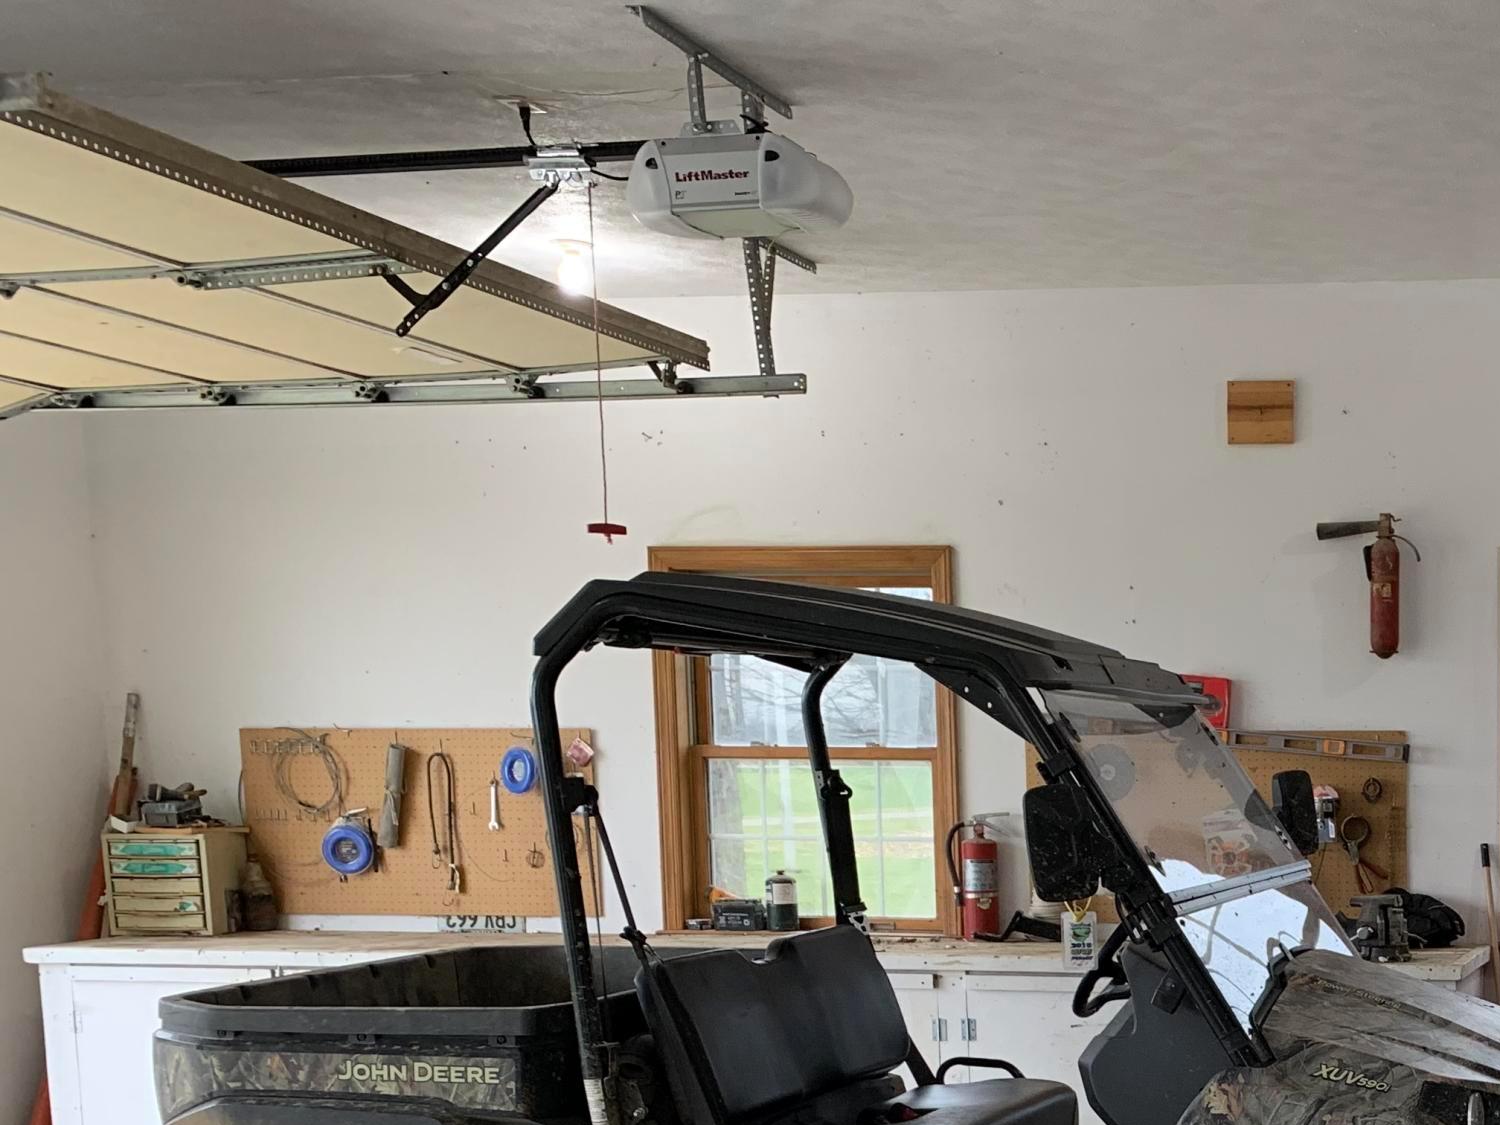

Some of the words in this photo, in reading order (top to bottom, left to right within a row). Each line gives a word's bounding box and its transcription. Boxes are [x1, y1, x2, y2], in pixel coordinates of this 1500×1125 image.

[674, 169, 750, 183] LiftMaster
[338, 1060, 408, 1082] JOHN
[413, 1062, 500, 1084] DEERE
